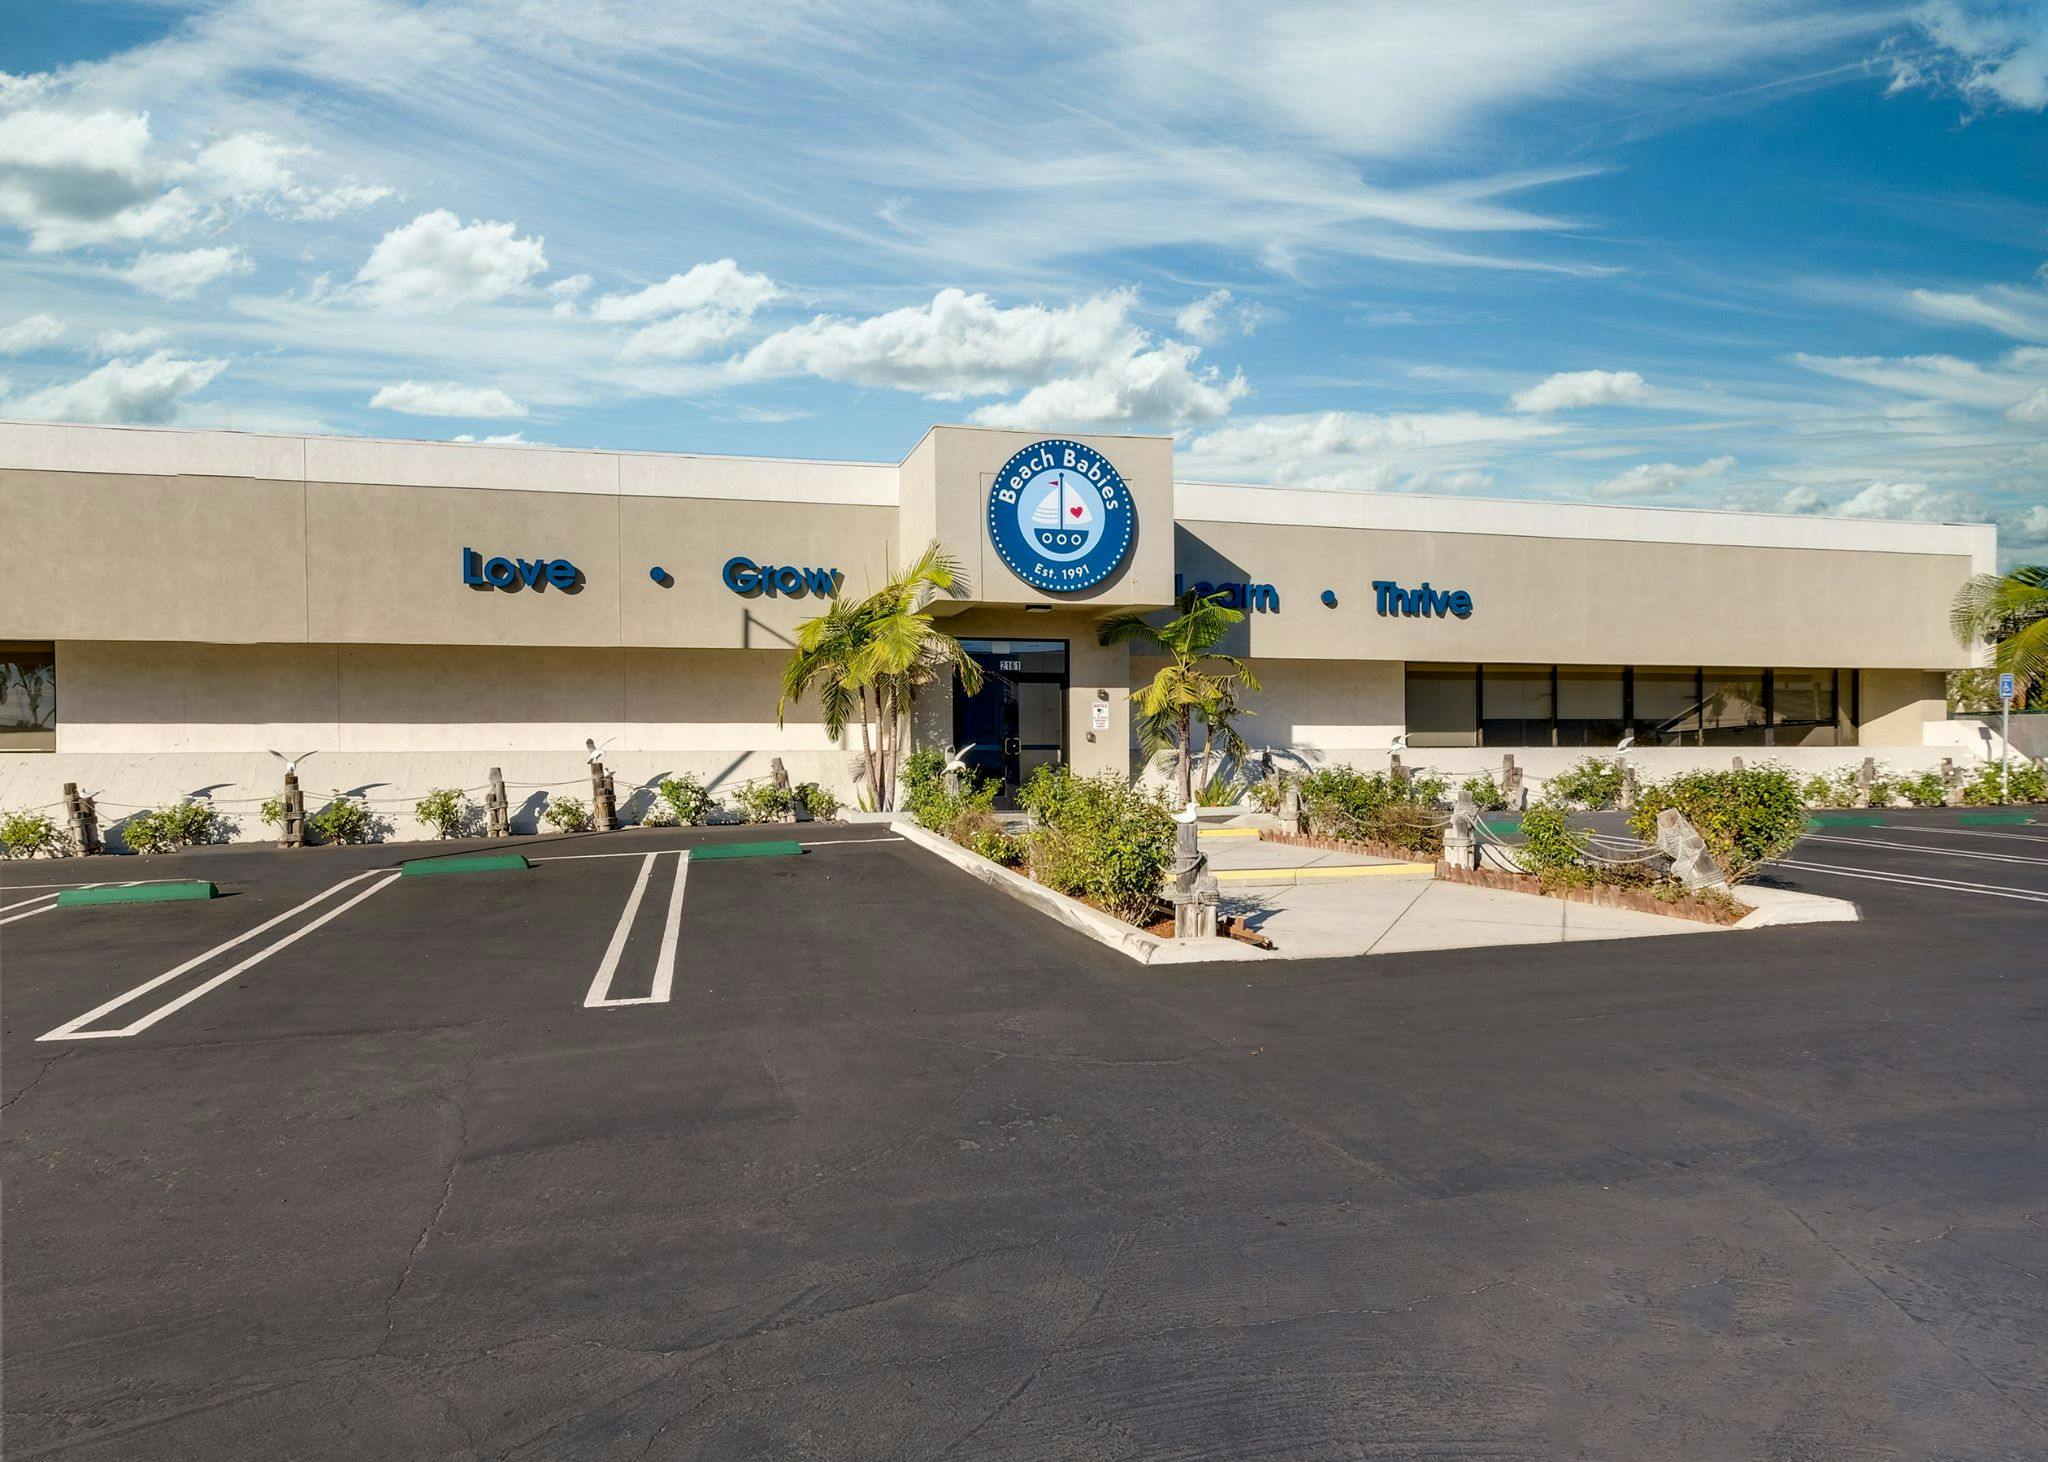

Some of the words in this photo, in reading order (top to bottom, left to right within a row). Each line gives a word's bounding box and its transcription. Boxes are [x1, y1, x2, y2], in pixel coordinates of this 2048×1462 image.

[998, 448, 1055, 505] Beach
[1063, 448, 1119, 510] Babies
[463, 547, 577, 589] Love
[722, 556, 838, 594] Grow
[1372, 580, 1473, 616] Thrive
[1034, 562, 1058, 580] Est.
[1062, 564, 1090, 580] 1991
[1000, 661, 1020, 671] 2161
